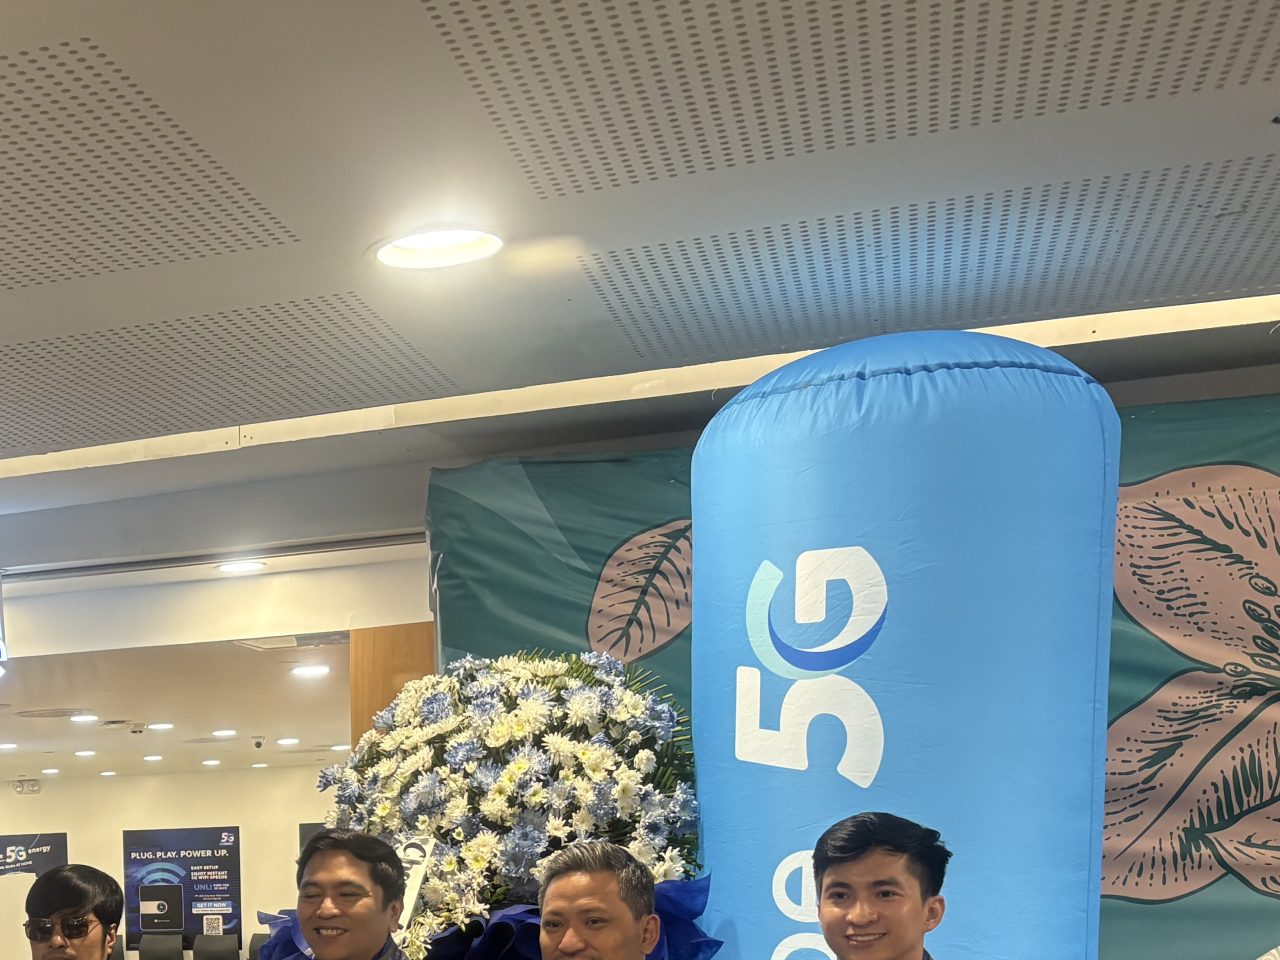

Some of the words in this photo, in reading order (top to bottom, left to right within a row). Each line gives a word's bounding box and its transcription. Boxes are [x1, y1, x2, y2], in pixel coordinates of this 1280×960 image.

[735, 545, 888, 788] 5G
[220, 832, 235, 843] 5G
[6, 846, 27, 862] 5G
[27, 845, 51, 854] energy
[131, 851, 155, 859] PLUG.
[156, 851, 179, 859] PLAY.
[180, 850, 212, 858] POWER
[214, 849, 229, 857] UP.
